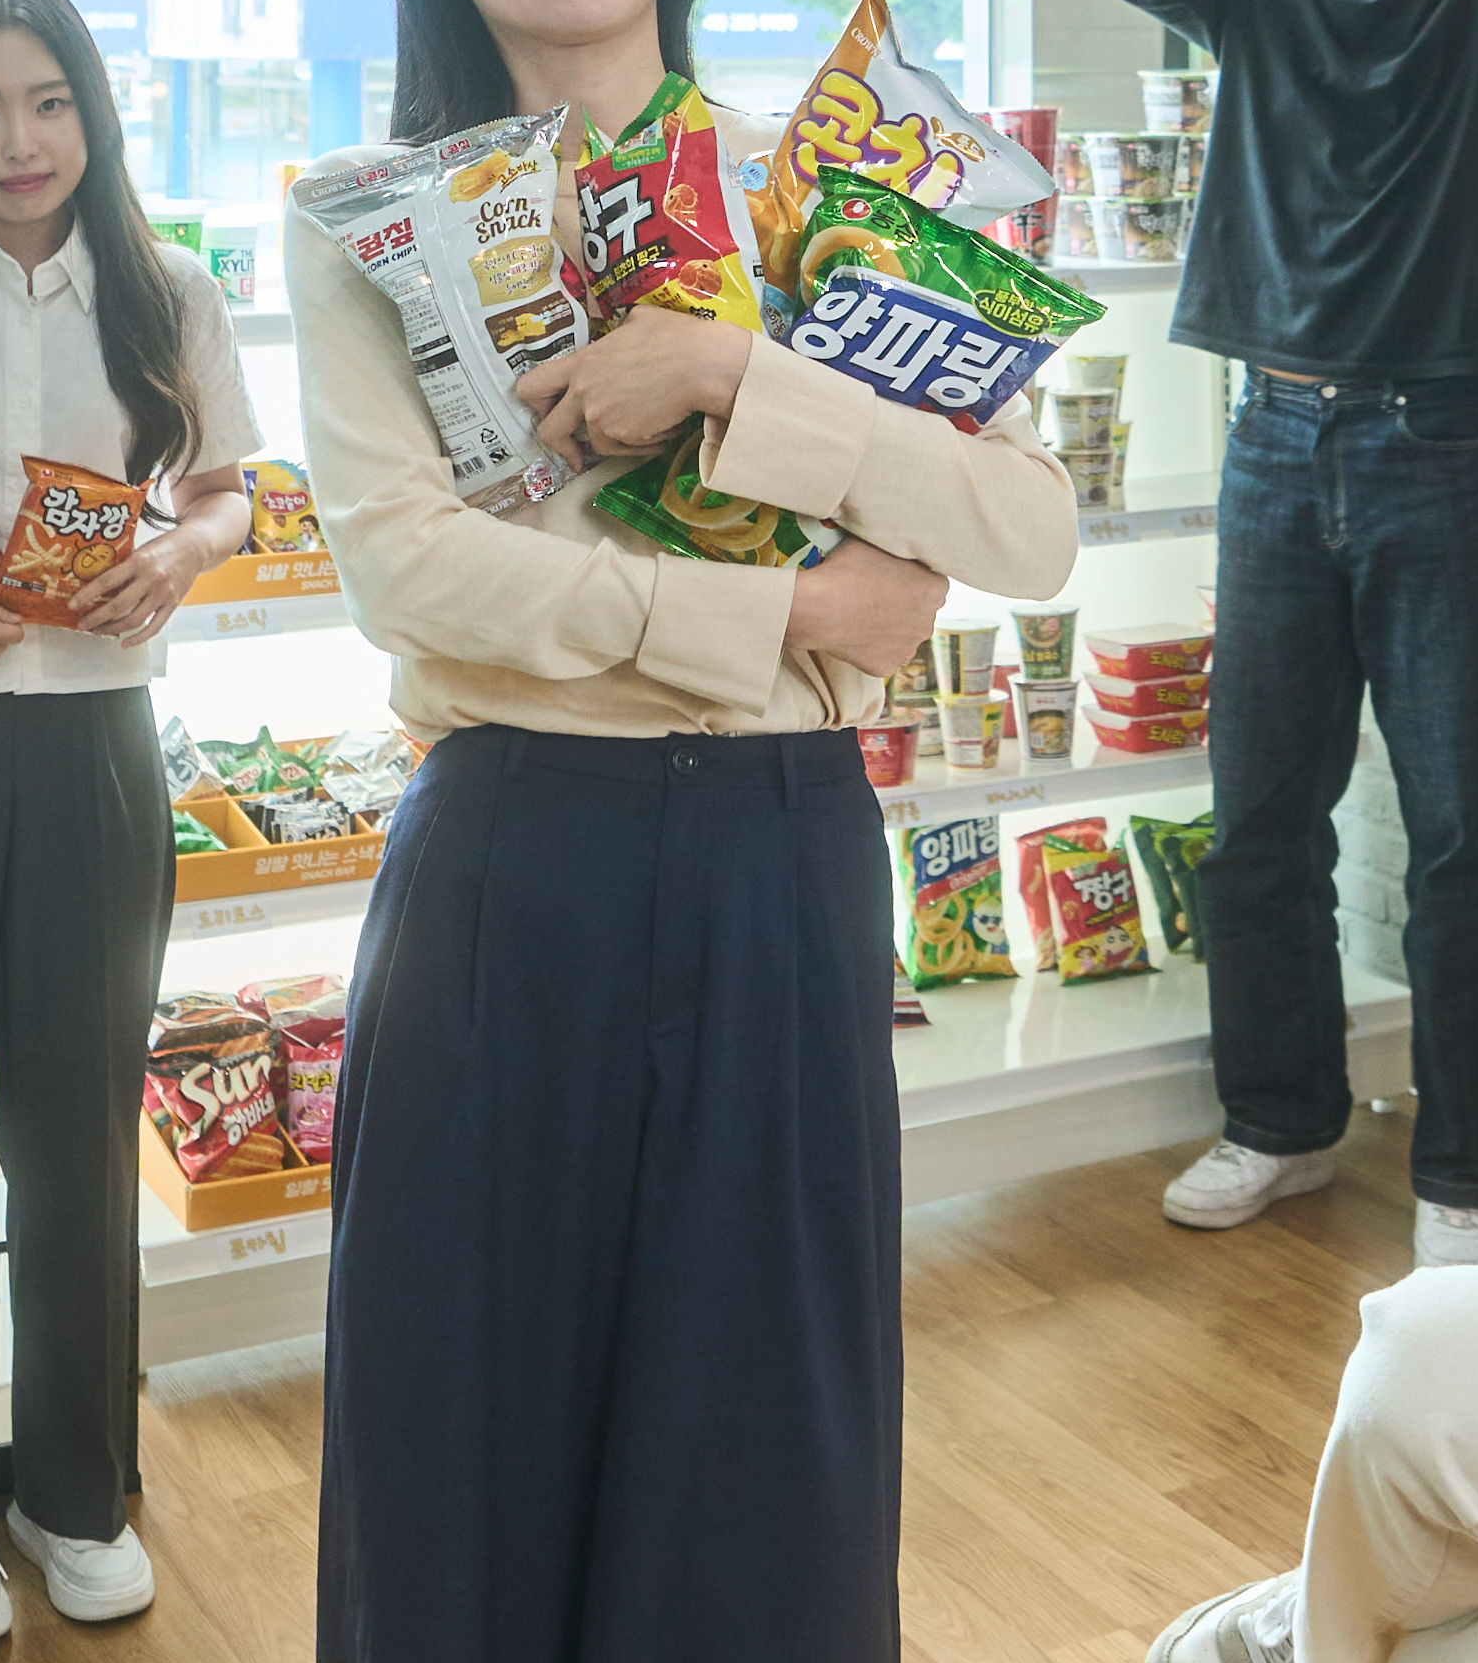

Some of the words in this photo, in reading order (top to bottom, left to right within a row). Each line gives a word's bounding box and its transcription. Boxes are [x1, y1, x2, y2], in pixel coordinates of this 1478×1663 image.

[850, 27, 882, 58] CROWN
[310, 180, 347, 199] CROWN
[498, 159, 540, 187] 고소바삭
[475, 209, 542, 245] Snack
[479, 195, 529, 223] Corn
[356, 216, 415, 265] 콘칩
[366, 256, 390, 275] CORN
[978, 297, 1049, 334] 식이섬유
[790, 290, 1023, 409] 양파링
[42, 485, 132, 541] 감자깡
[921, 816, 1000, 878] 양파링
[1072, 868, 1133, 912] 짱구
[179, 1054, 272, 1140] Sun
